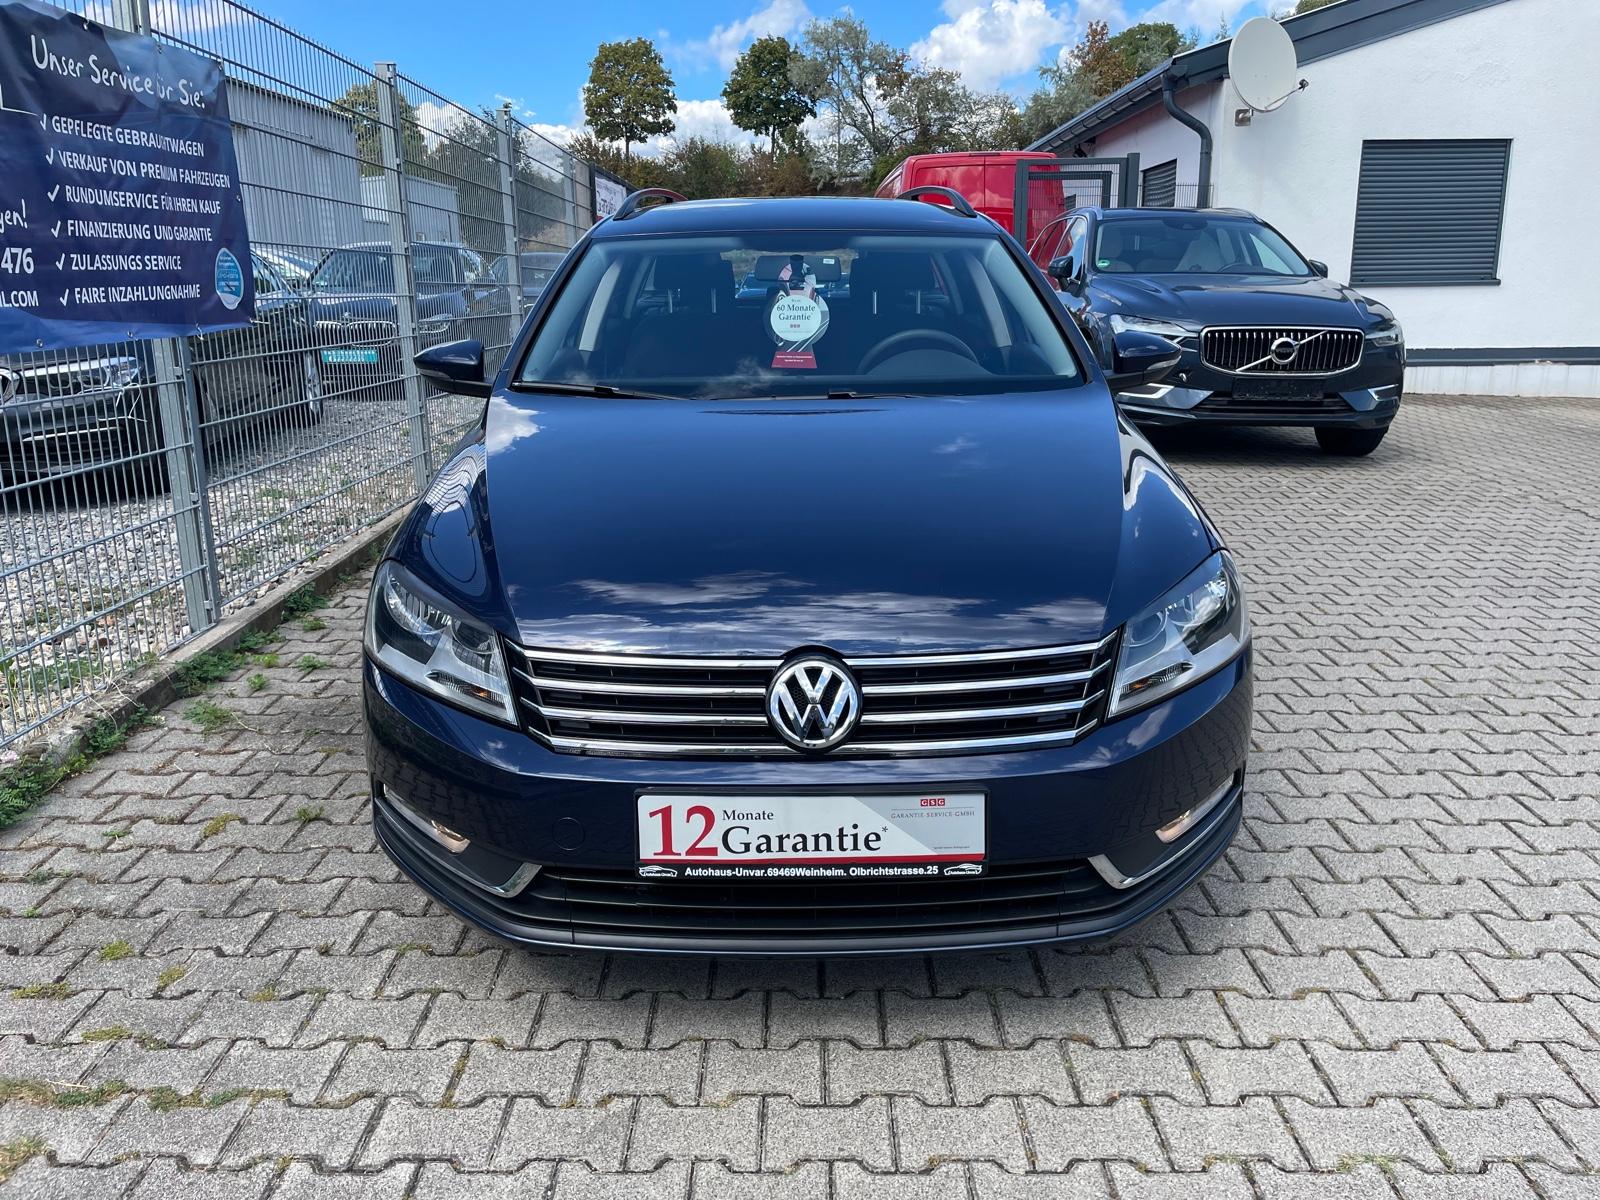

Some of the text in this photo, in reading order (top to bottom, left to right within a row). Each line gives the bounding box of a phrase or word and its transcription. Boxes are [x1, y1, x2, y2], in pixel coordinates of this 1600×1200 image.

[31, 34, 206, 109] Unser Service ür Sie:
[51, 114, 205, 157] GEPFLEGTE GEBRAUHTWAGEN
[58, 151, 108, 174] VERKAUF
[109, 158, 137, 177] VON
[179, 168, 231, 189] FAHRZEUGEN
[66, 185, 159, 210] RUNDUMSERVICE
[173, 196, 199, 213] IHREN
[199, 199, 221, 214] KAUF
[67, 219, 213, 242] FINANZIERUNG UND GARANTIE
[0, 247, 35, 274] 476
[70, 253, 182, 271] ZULASSUNGS SERVICE
[0, 290, 39, 308] L.COM
[74, 283, 201, 304] FAIRE INZAHLUNGNAHME
[787, 304, 816, 312] Monate
[920, 798, 946, 807] GSG
[722, 809, 774, 822] Monate
[648, 804, 719, 857] 12
[849, 865, 939, 877] Olbrichtstrasse.25
